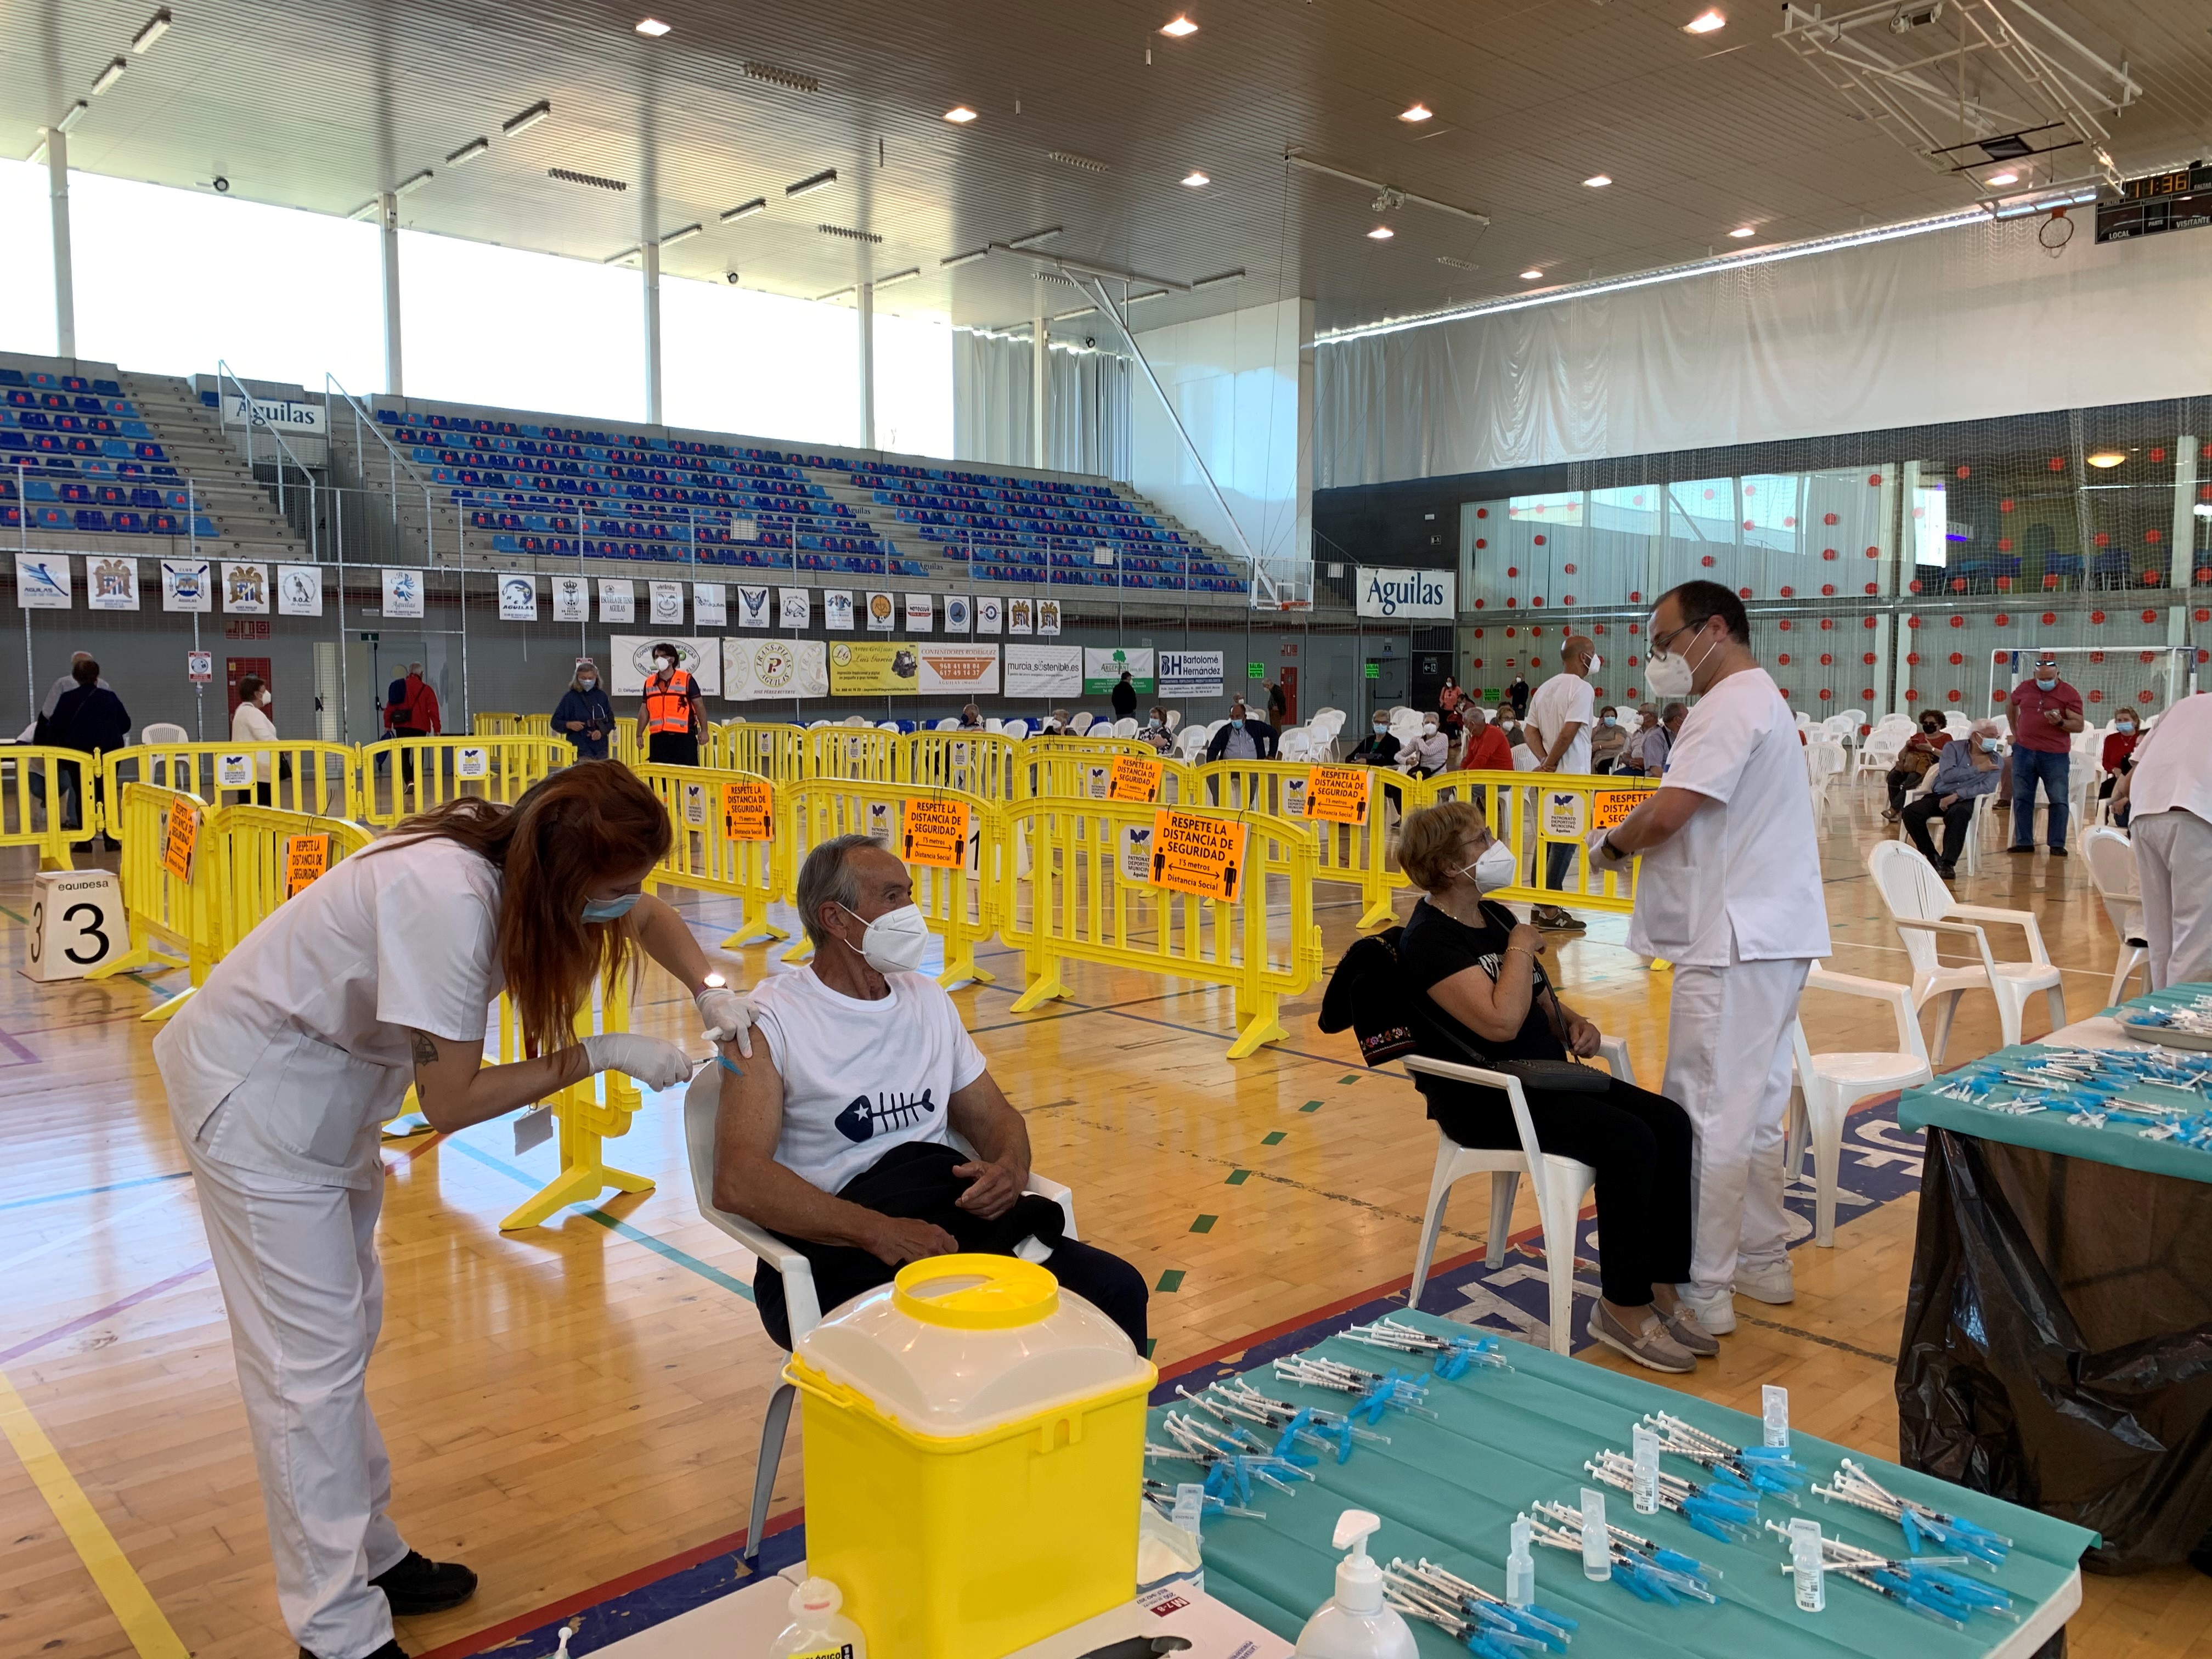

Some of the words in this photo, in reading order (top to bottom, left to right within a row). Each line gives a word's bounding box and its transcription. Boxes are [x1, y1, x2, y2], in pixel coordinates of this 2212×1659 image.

[2136, 173, 2187, 199] 11:36
[2194, 182, 2211, 190] FALTAS
[2176, 216, 2211, 228] VISITANTE
[2109, 230, 2130, 240] LOCAL
[1367, 570, 1443, 616] Águilas
[756, 644, 792, 669] TRANS-PILAS
[853, 654, 868, 663] Luis
[1183, 654, 1218, 664] Bartolomé
[1161, 655, 1182, 675] BH
[1183, 666, 1220, 675] Hernández
[1122, 759, 1145, 769] RESPETE
[1118, 766, 1147, 778] DISTANCIA
[1148, 771, 1155, 779] DE
[1321, 770, 1350, 780] RESPETE
[1351, 773, 1360, 781] LA
[1119, 774, 1150, 786] SEGURIDAD
[1314, 778, 1352, 790] DISTANCIA
[1355, 782, 1364, 791] DE
[731, 786, 753, 794] RESPETE
[1317, 787, 1358, 798] SEGURIDAD
[728, 795, 758, 804] DISTANCIA
[759, 795, 766, 804] DE
[1610, 794, 1647, 803] RESPETE
[731, 805, 763, 813] SEGURIDAD
[916, 802, 946, 813] RESPETE
[947, 805, 956, 814] LA
[1317, 808, 1338, 816] Distancia
[1603, 804, 1637, 813] DISTAN
[911, 812, 950, 825] DISTANCIA
[950, 816, 961, 826] DE
[915, 823, 956, 836] SEGURIDAD
[1171, 816, 1212, 833] RESPETE
[1214, 823, 1227, 836] LA
[1163, 827, 1217, 848] DISTANCIA
[1220, 838, 1234, 850] DE
[296, 840, 313, 851] RESPETE
[313, 840, 320, 851] LA
[969, 830, 980, 871] 1
[1167, 841, 1226, 861] SEGURIDAD
[292, 854, 315, 866] DISTANCIA
[315, 854, 323, 866] DE
[915, 851, 936, 859] Distancia
[1187, 861, 1210, 871] metros
[294, 868, 319, 879] SEGURIDAD
[1167, 873, 1197, 887] Distancia
[1198, 879, 1218, 891] Social
[30, 901, 43, 964] 3
[63, 902, 110, 966] 3
[1156, 1602, 1174, 1612] 7-8
[1170, 1597, 1188, 1608] M
